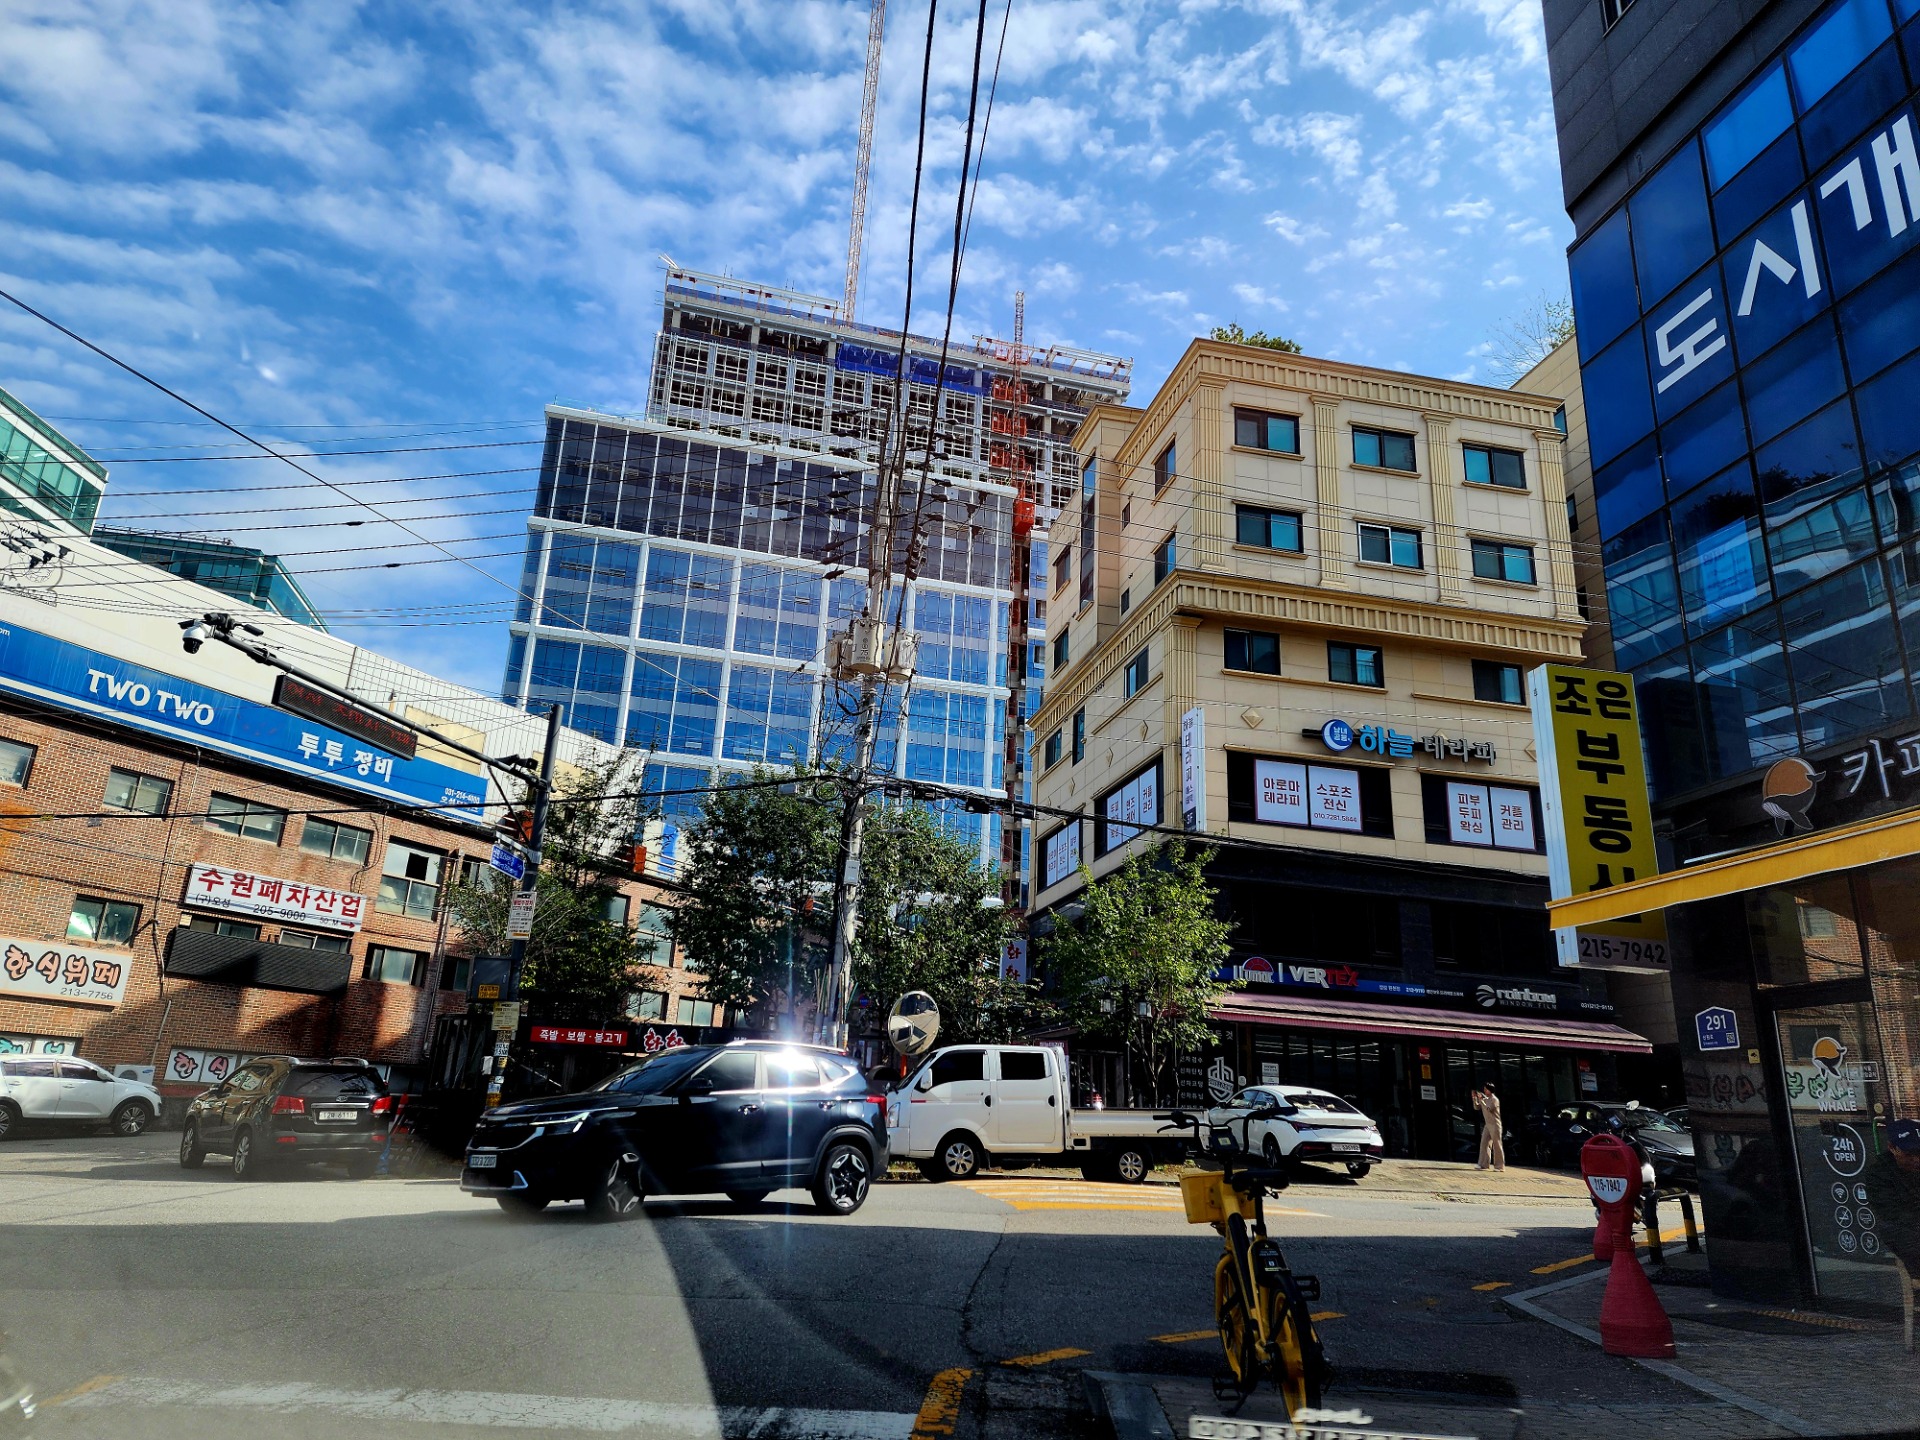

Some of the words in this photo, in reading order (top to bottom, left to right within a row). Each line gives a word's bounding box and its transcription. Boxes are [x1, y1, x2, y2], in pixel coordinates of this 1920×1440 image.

[87, 668, 150, 707] TWO
[157, 689, 215, 726] TWO
[1554, 675, 1632, 720] 조은
[1358, 724, 1415, 759] 하늘
[1422, 735, 1496, 766] 테라피
[298, 731, 344, 768] 투투
[353, 750, 393, 783] 정비
[1143, 785, 1152, 799] 커플
[1264, 777, 1300, 792] 아로마
[1317, 783, 1352, 798] 스포츠
[1143, 799, 1153, 813] 관리
[1264, 791, 1300, 806] 테라피
[1323, 798, 1347, 811] 전신
[1458, 793, 1480, 806] 피부
[1459, 807, 1481, 820] 두피
[1500, 804, 1523, 817] 커플
[1460, 820, 1482, 833] 왁싱
[1502, 818, 1524, 831] 관리
[198, 868, 361, 918] 수원폐차산업
[253, 904, 306, 921] 205-9000
[1580, 937, 1667, 964] 215-7942
[4, 944, 121, 988] 한식뷔페
[1289, 966, 1359, 988] VERTEX
[60, 988, 113, 1000] 213-7756
[1496, 988, 1556, 1003] rainbow
[1500, 1000, 1533, 1008] WINDOW
[1706, 1015, 1727, 1030] 291
[539, 1029, 559, 1041] 족발
[566, 1031, 586, 1042] 보쌈
[595, 1032, 622, 1044] 불고기
[174, 1052, 229, 1080] 한식
[1818, 1101, 1857, 1112] WHALE
[1832, 1138, 1855, 1151] 24h
[1834, 1152, 1856, 1162] OPEN
[1594, 1178, 1622, 1192] 215-7942
